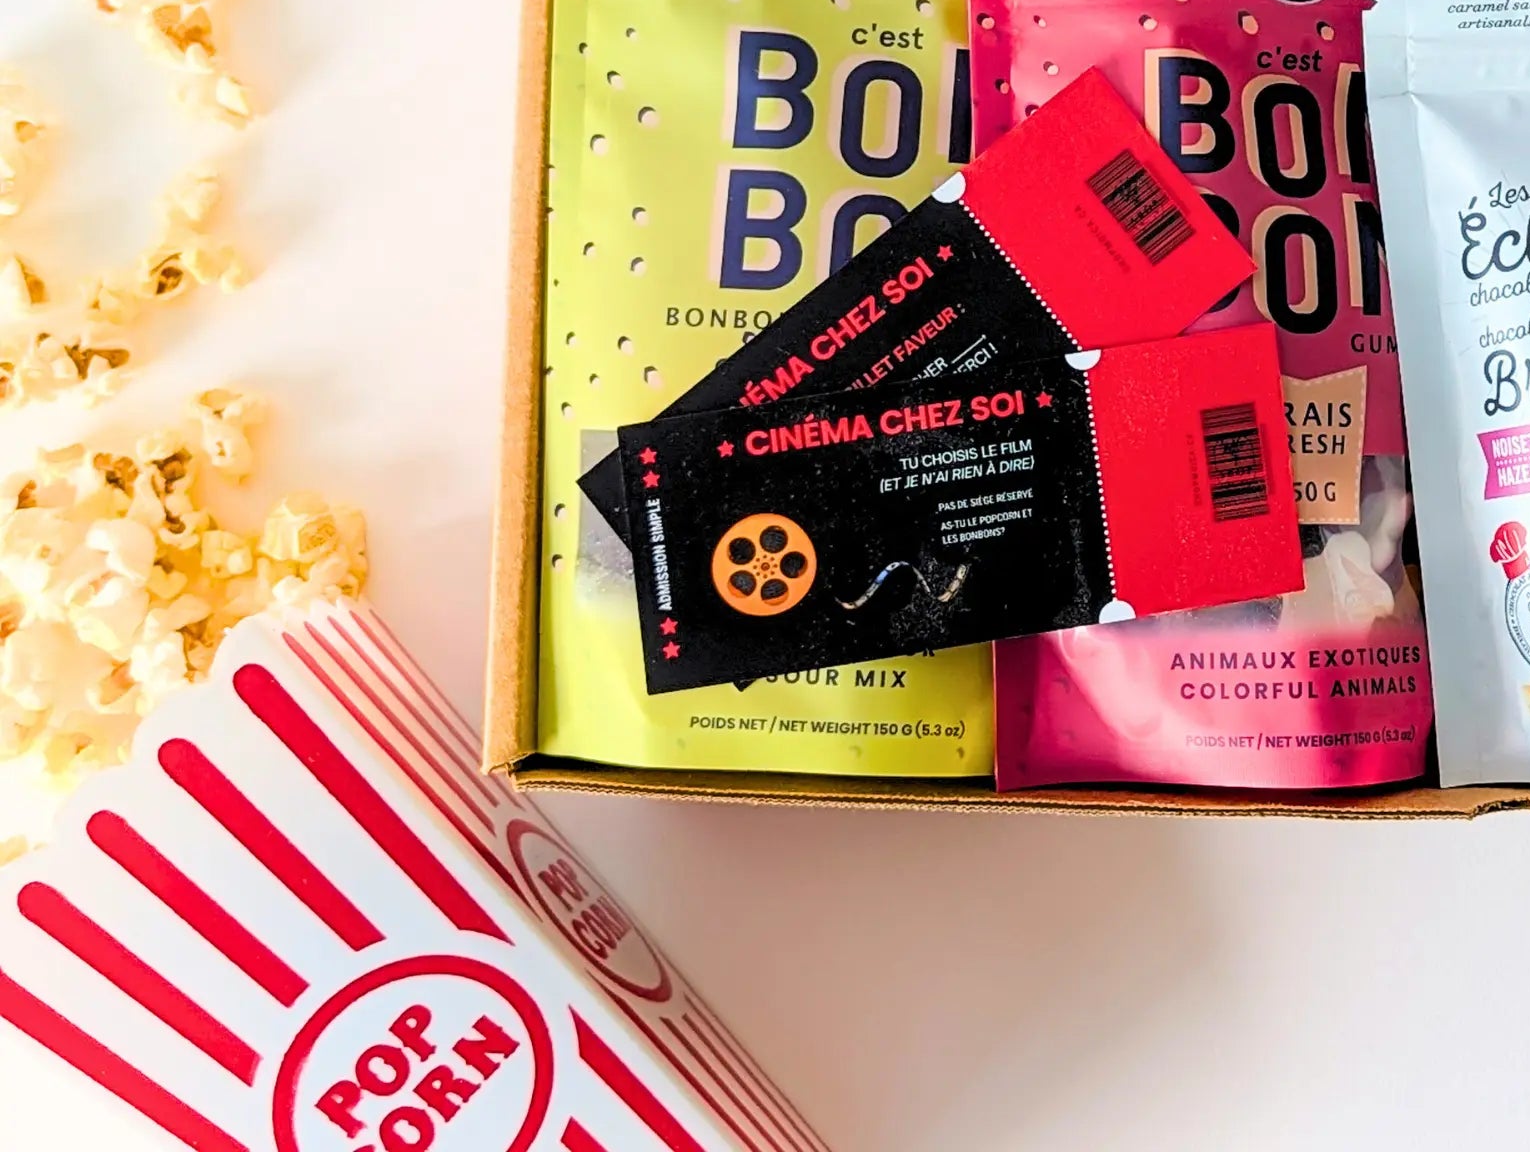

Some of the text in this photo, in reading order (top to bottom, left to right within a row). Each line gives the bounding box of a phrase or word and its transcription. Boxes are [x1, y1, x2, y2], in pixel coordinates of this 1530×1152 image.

[1447, 0, 1509, 13] caramel
[851, 23, 924, 50] c'est
[1256, 47, 1323, 72] c'est
[731, 29, 974, 179] BO
[810, 256, 935, 361] CHEZ SOI
[892, 306, 959, 363] FAVEUR
[745, 390, 1025, 456] CINÉMA CHEZ SOI
[1284, 402, 1351, 427] RAIS
[900, 439, 1033, 470] TU CHOISIS LE FILM
[880, 455, 1035, 494] (ET JE N'AI RIEN À DIRE)
[1324, 481, 1336, 502] G
[938, 498, 969, 512] PAS DE
[940, 508, 1033, 531] AS-TU LE POPCORN ET
[942, 527, 1006, 545] LES BONBONS?
[647, 498, 673, 611] ADMISSION SIMPLE
[1171, 646, 1421, 670] ANIMAUX EXOTIQUES
[854, 670, 907, 688] MIX
[1180, 676, 1416, 699] COLORFUL ANIMALS
[690, 716, 736, 730] POIDS
[739, 718, 767, 731] NET
[778, 720, 808, 732] NET
[811, 721, 870, 735] WEIGHT
[873, 723, 898, 735] 150
[901, 723, 913, 736] G
[915, 720, 942, 739] (5.3
[944, 720, 965, 739] oz)
[1185, 734, 1226, 747] POIDS
[1228, 736, 1254, 747] NET
[1265, 736, 1292, 748] NET
[1295, 734, 1352, 747] WEIGHT
[1353, 732, 1371, 744] 150
[538, 858, 589, 913] POP
[572, 896, 632, 960] CORN
[315, 1004, 437, 1139] POP
[354, 1015, 520, 1152] ORN
